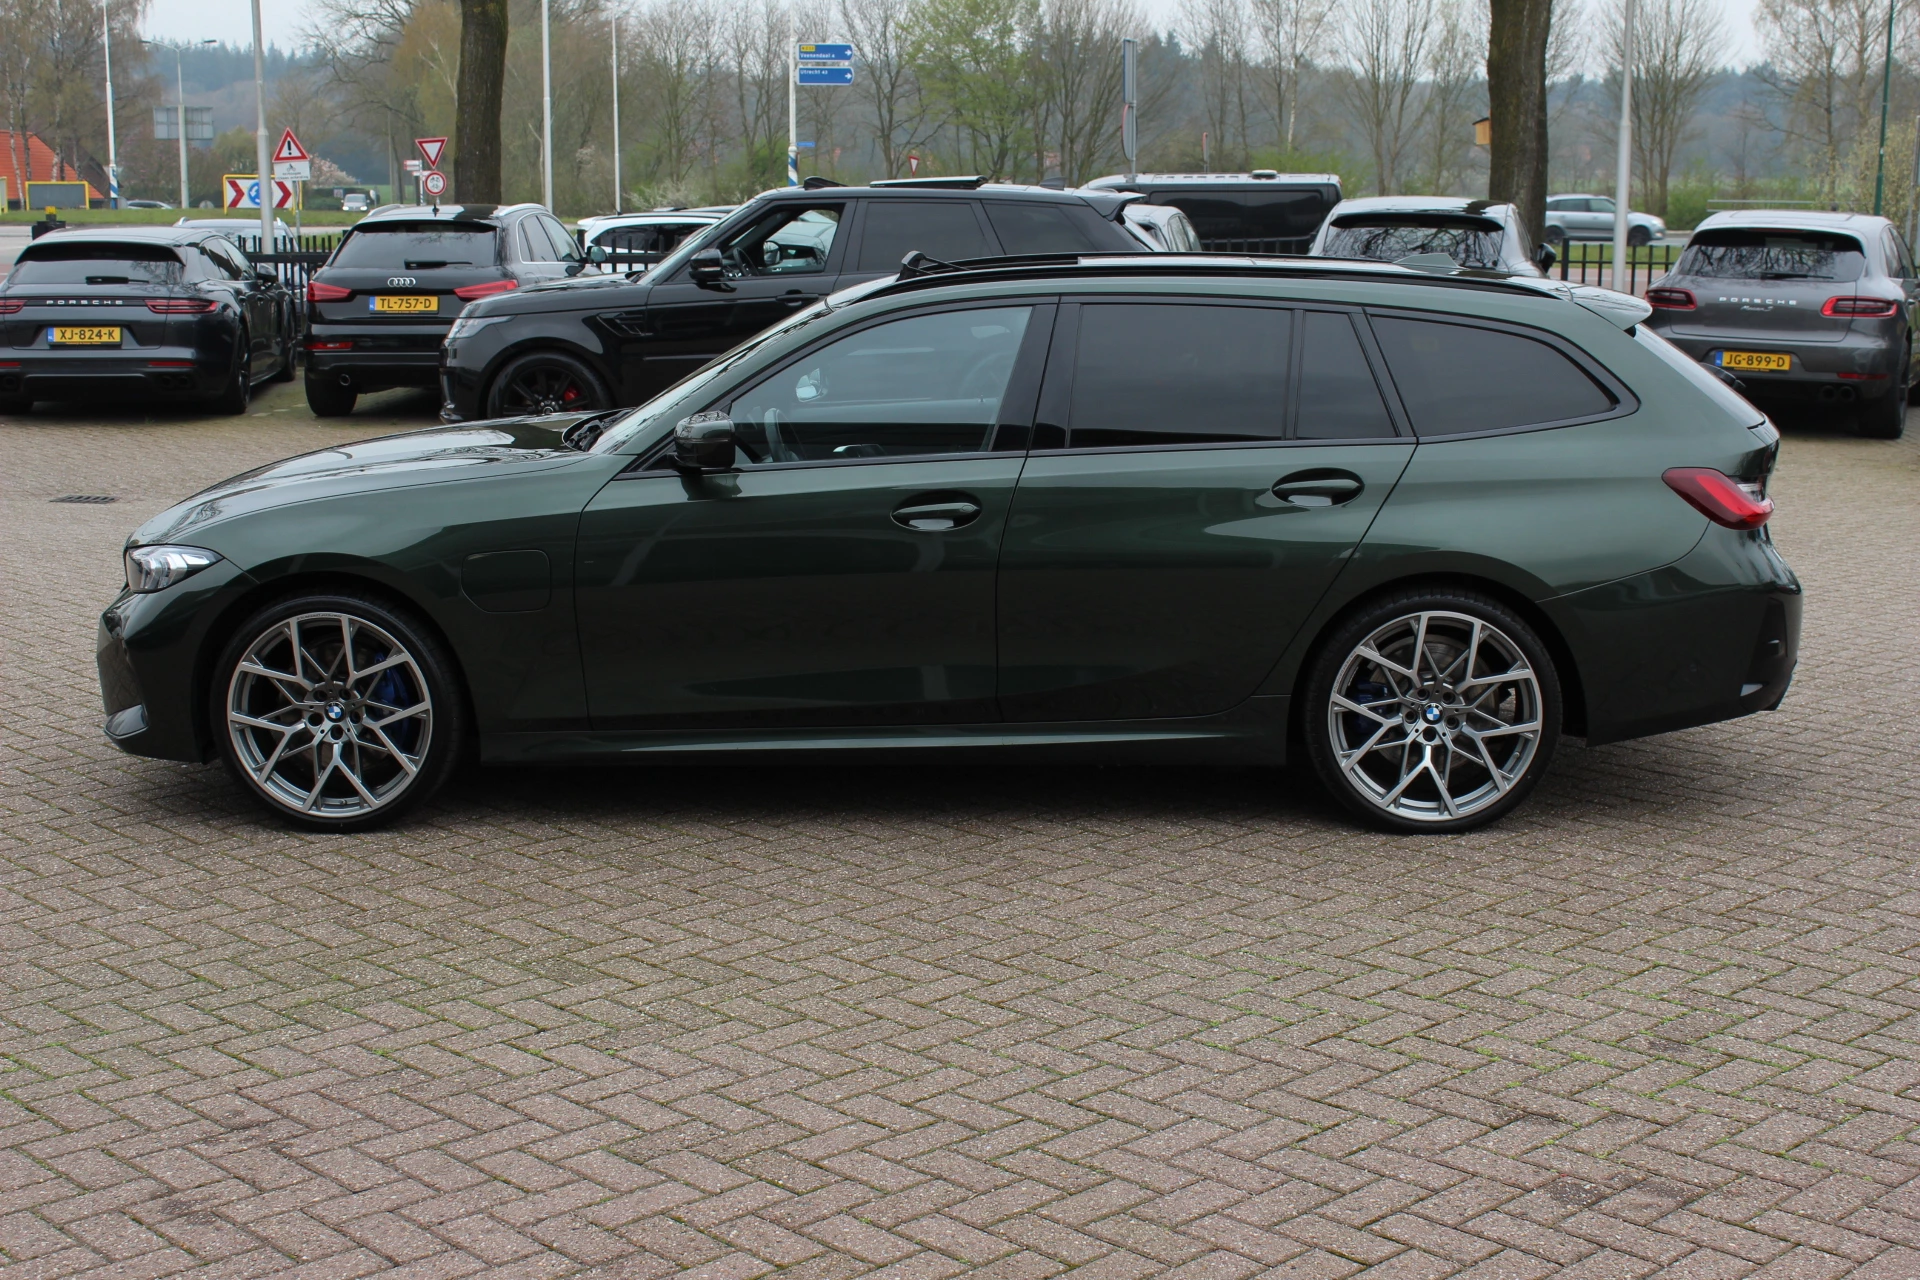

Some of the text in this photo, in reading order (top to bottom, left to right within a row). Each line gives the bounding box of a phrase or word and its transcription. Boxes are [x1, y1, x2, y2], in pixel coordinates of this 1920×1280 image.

[379, 298, 432, 309] TL-757-D
[1719, 296, 1797, 305] PORSCHE
[59, 329, 115, 340] XJ-824-K
[1726, 354, 1785, 368] JG-899-D
